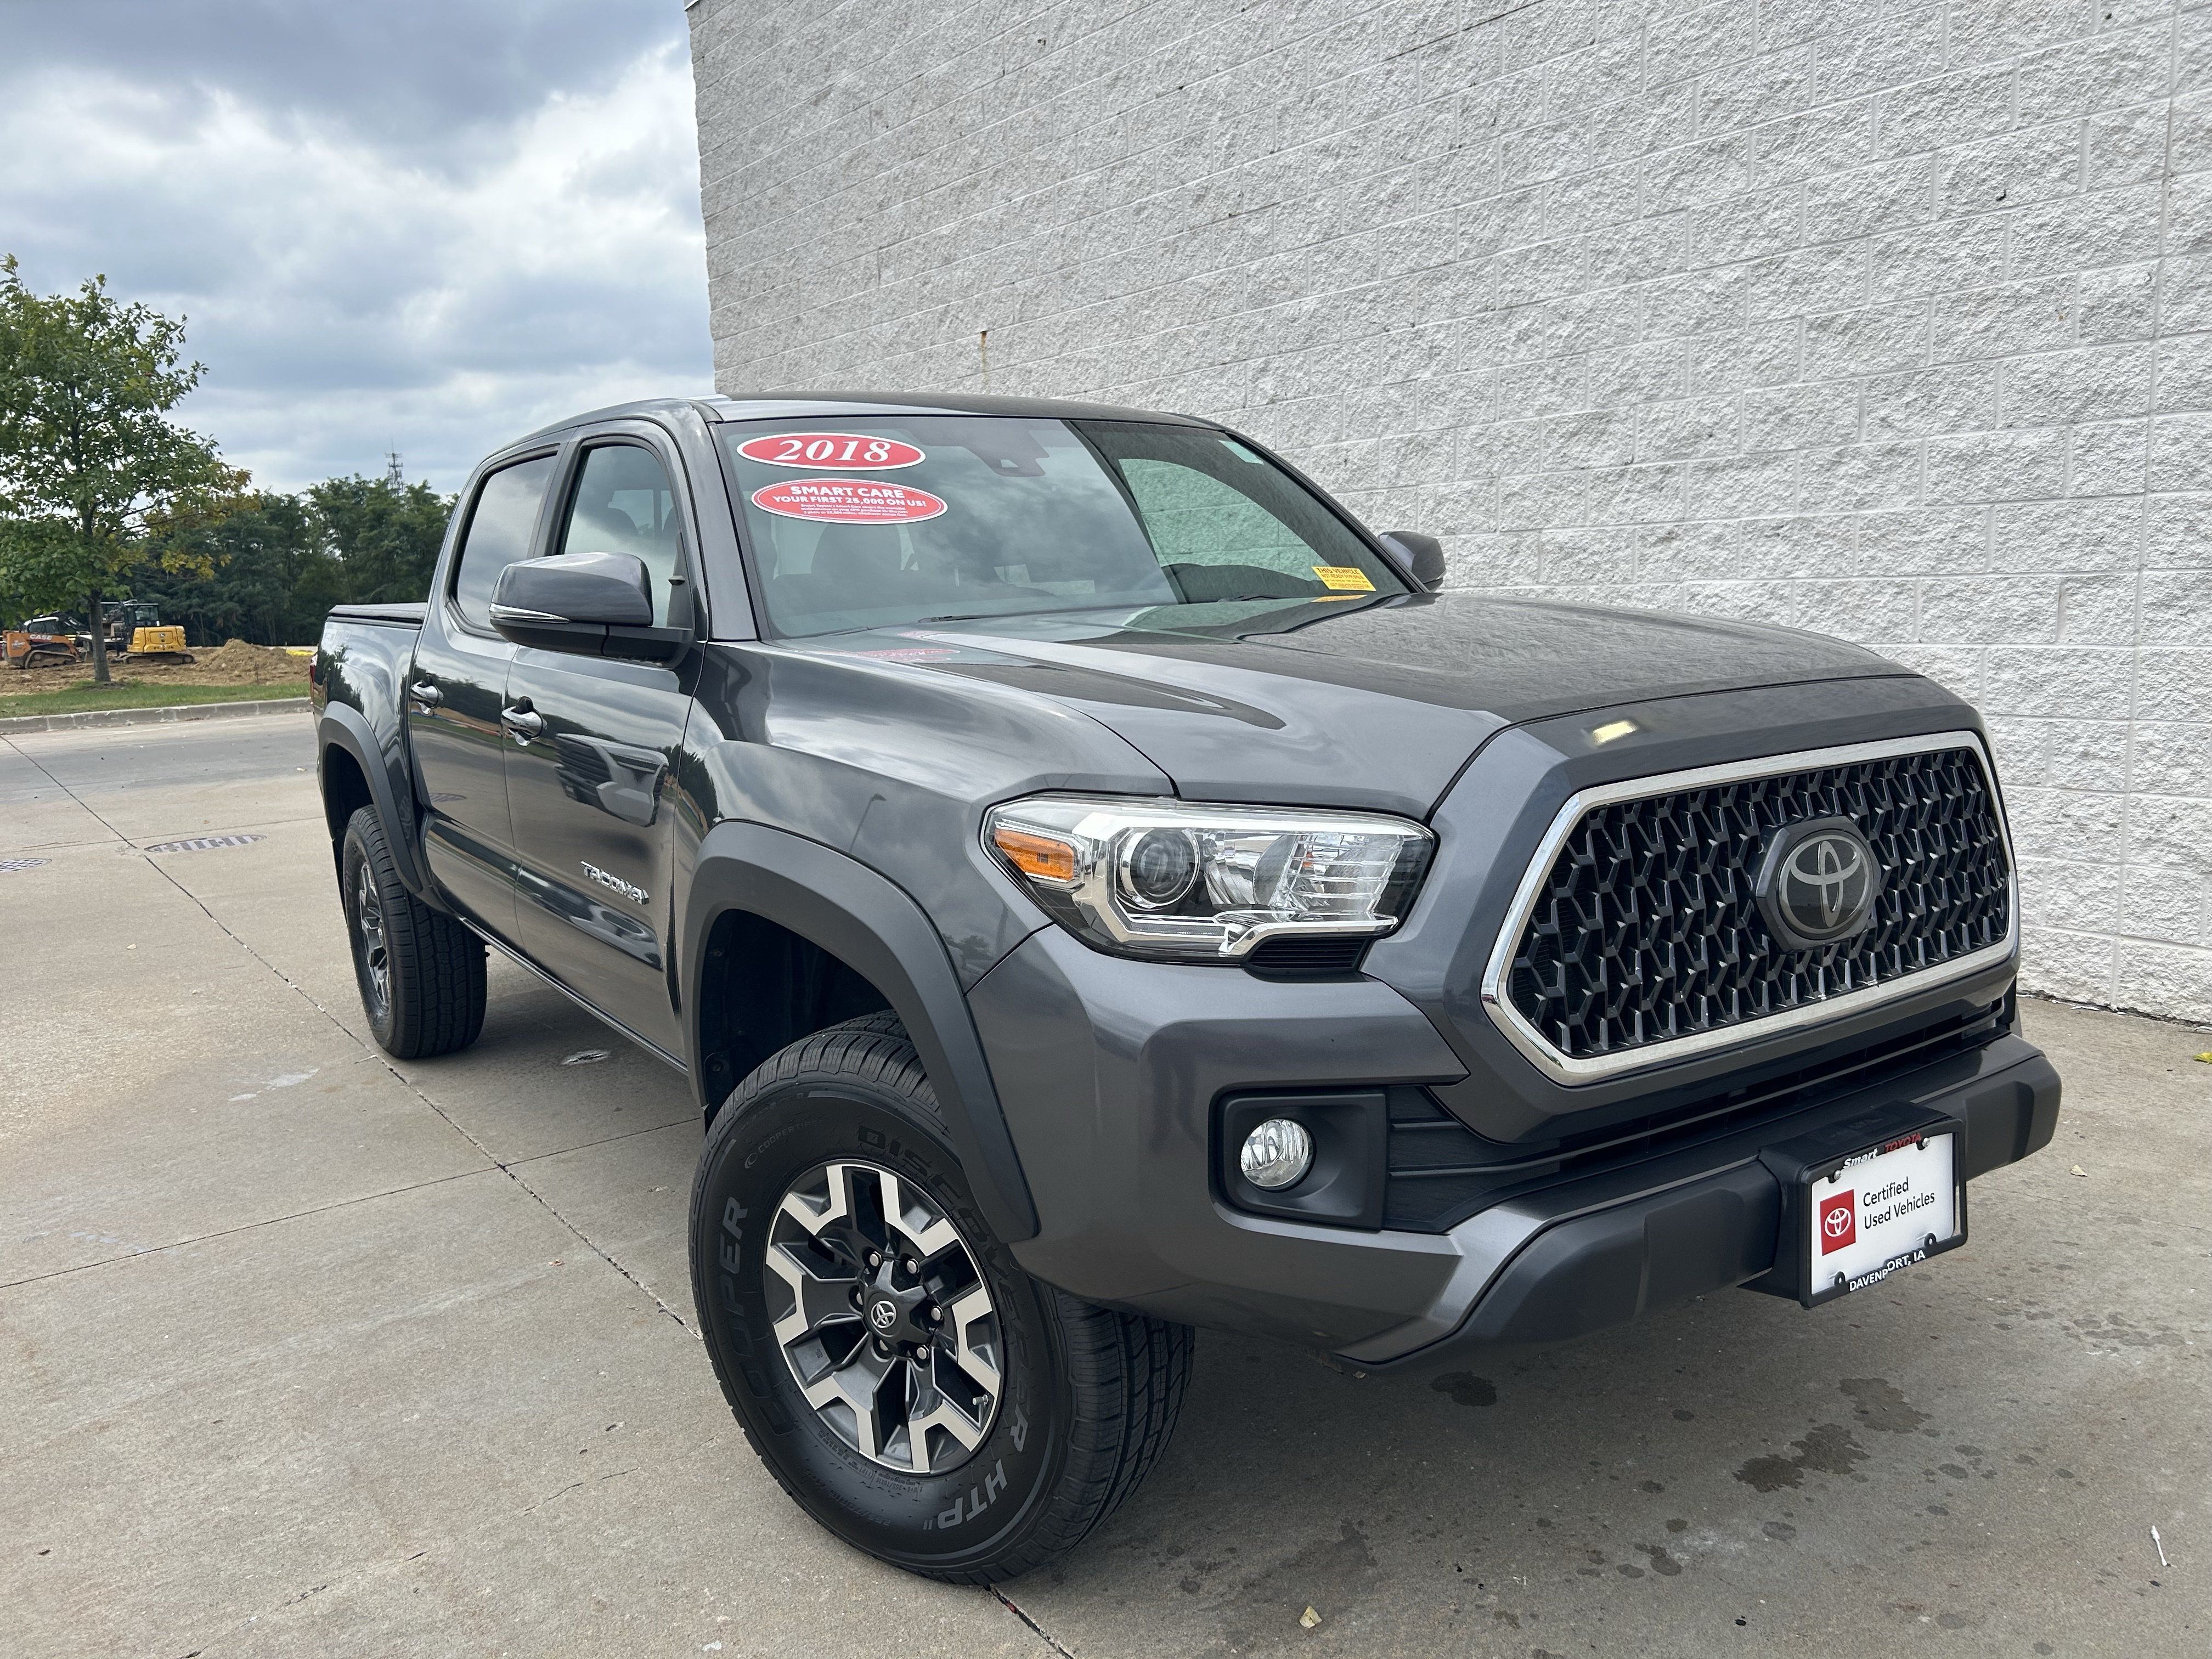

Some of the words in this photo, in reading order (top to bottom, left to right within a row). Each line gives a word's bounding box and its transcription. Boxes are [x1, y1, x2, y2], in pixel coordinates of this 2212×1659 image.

[773, 439, 891, 462] 2018
[790, 486, 854, 496] SMART
[857, 488, 905, 498] CARE
[580, 860, 649, 905] TACOMA
[1843, 1148, 1877, 1170] Smart
[1884, 1132, 1922, 1153] TOYOTA
[1863, 1176, 1909, 1207] Certified
[1864, 1206, 1891, 1229] Used
[1894, 1190, 1935, 1218] Vehicles
[1849, 1254, 1911, 1292] DAVENPORT,
[1913, 1249, 1926, 1263] IA
